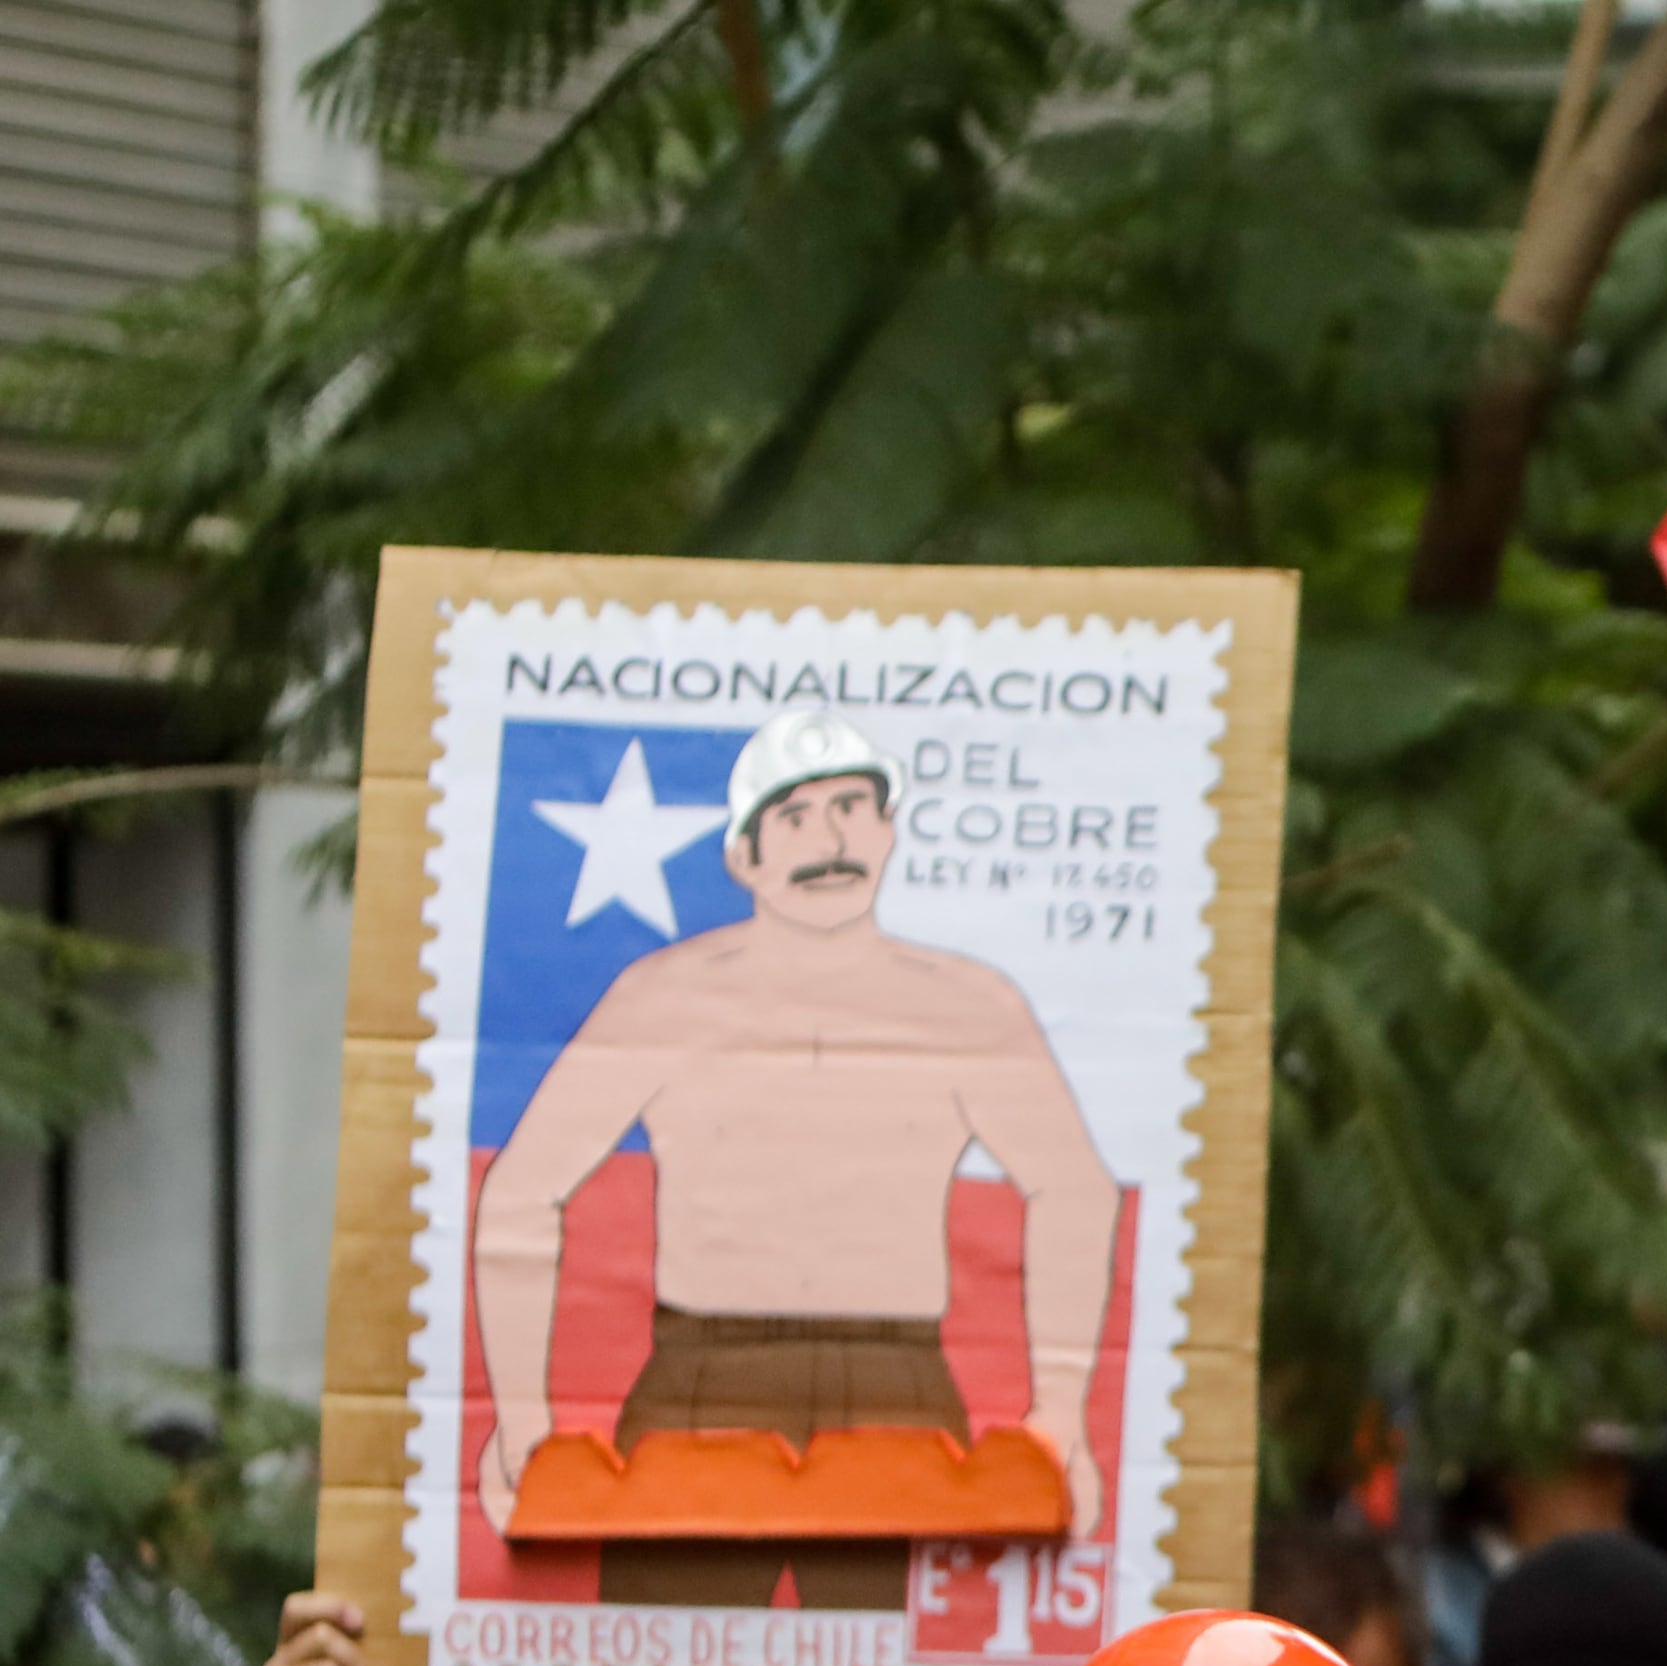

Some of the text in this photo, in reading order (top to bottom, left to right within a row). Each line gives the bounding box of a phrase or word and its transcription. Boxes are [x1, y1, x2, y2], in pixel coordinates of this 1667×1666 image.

[504, 653, 1169, 715] NACIONALIZACION
[912, 738, 1041, 788] DEL
[907, 798, 1159, 850] COBRE
[905, 856, 976, 886] LEY
[1045, 900, 1157, 940] 1971
